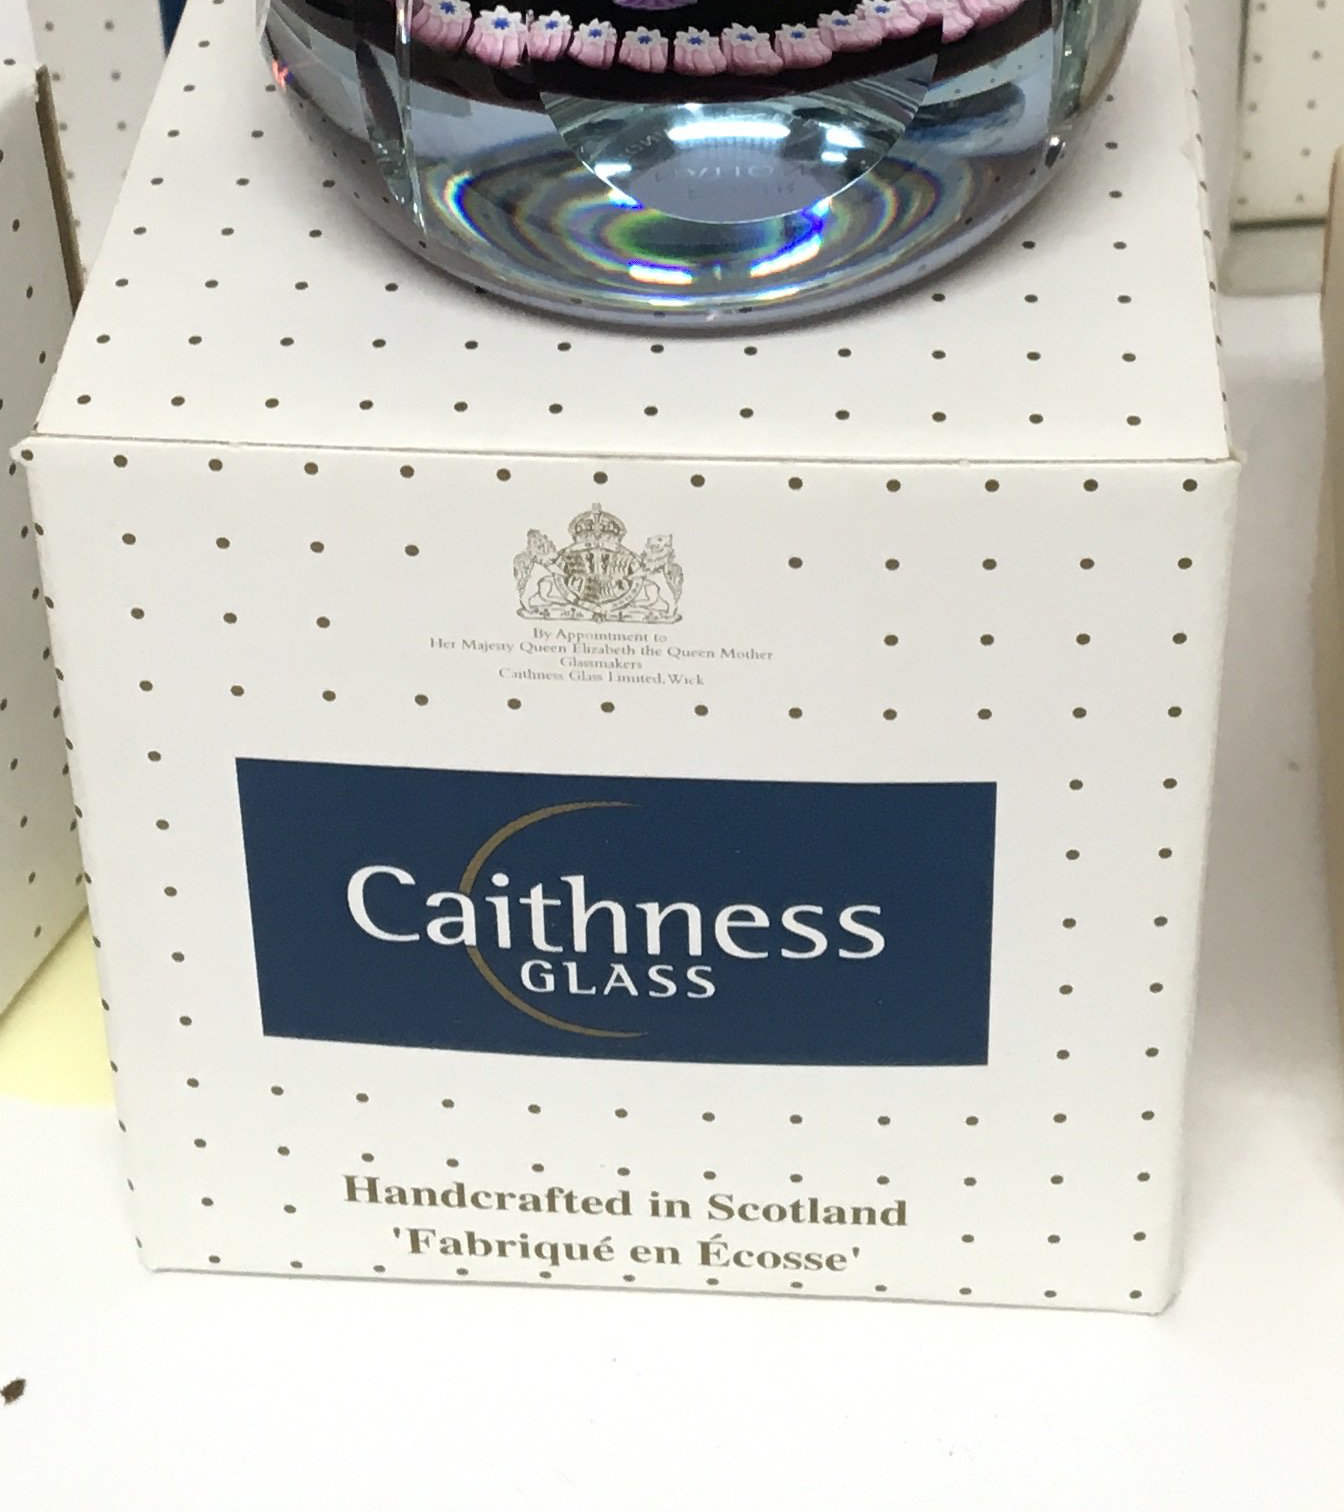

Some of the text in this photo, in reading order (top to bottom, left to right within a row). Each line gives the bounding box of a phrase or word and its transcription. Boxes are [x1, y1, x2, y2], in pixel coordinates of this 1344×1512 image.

[429, 636, 775, 661] Her Majesty Queen Elizabeth the Queen Mother
[532, 627, 668, 644] By Appointment to
[497, 667, 565, 682] Caithness
[346, 863, 887, 963] Caithness
[520, 959, 718, 1000] GLASS
[341, 1173, 909, 1229] Handcrafted in Scotland
[392, 1225, 862, 1274] 'Fabriqué en Écosse'
